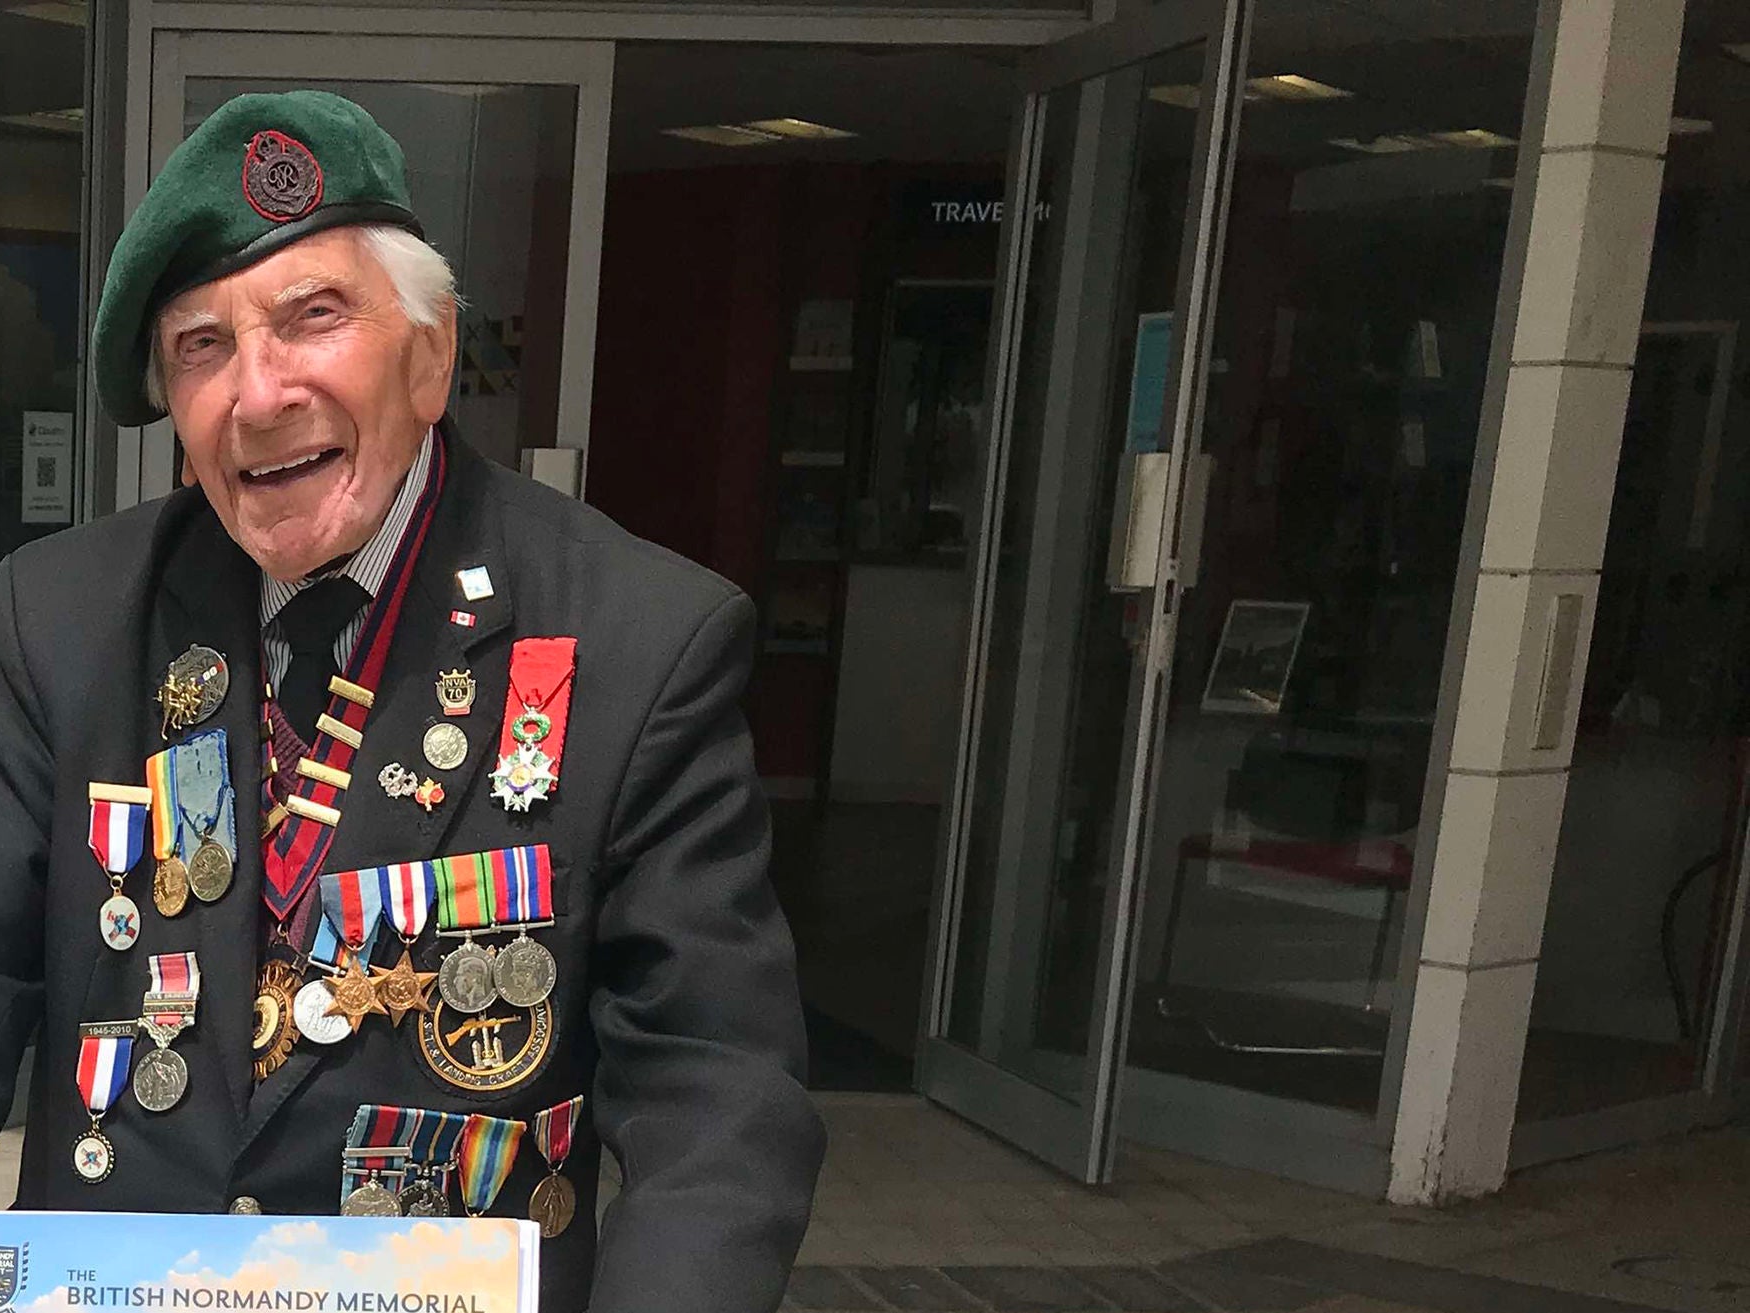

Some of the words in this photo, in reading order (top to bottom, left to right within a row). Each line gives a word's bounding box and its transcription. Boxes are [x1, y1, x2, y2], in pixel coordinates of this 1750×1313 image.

[931, 201, 1004, 222] TRAVE
[67, 1269, 96, 1281] THE
[67, 1286, 164, 1307] BRITISH
[173, 1288, 329, 1311] NORMANDY
